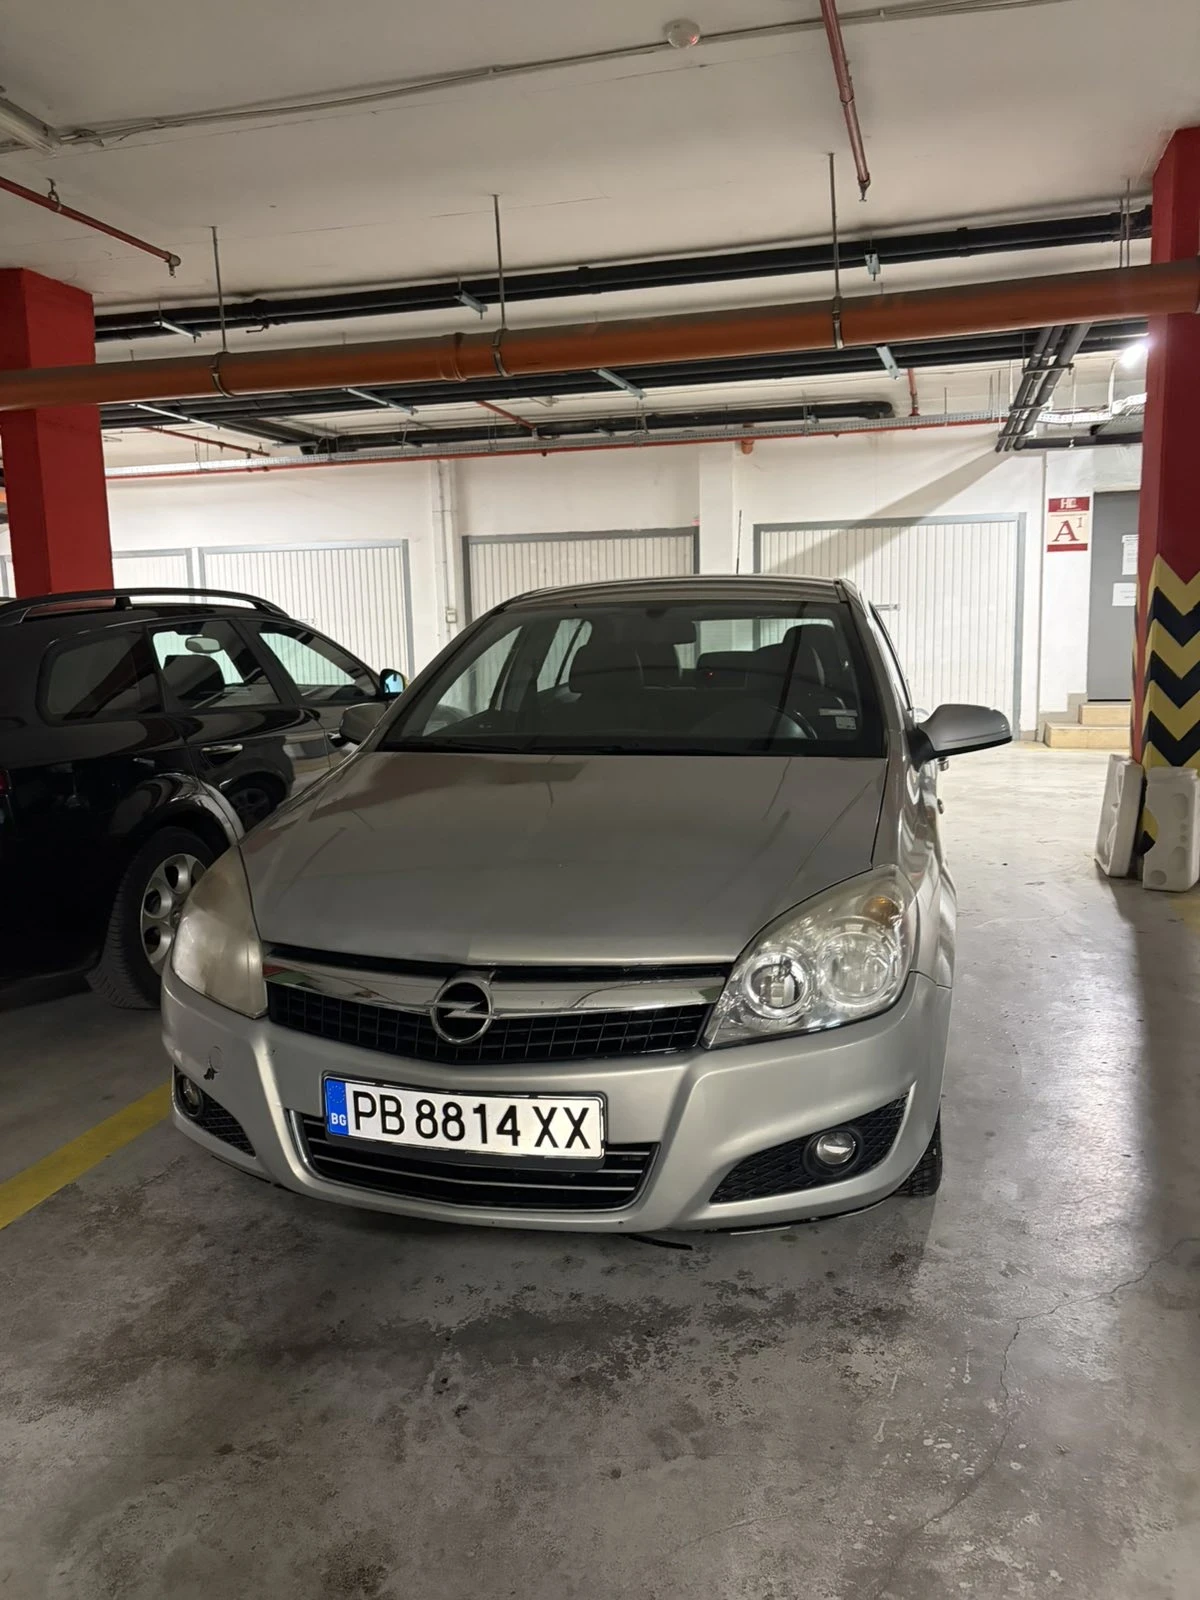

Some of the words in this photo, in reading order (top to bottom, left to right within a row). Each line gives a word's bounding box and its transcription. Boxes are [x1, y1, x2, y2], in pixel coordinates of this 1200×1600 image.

[331, 1113, 347, 1127] BG
[352, 1090, 405, 1136] PB
[415, 1099, 521, 1147] 8814
[532, 1105, 591, 1150] XX
